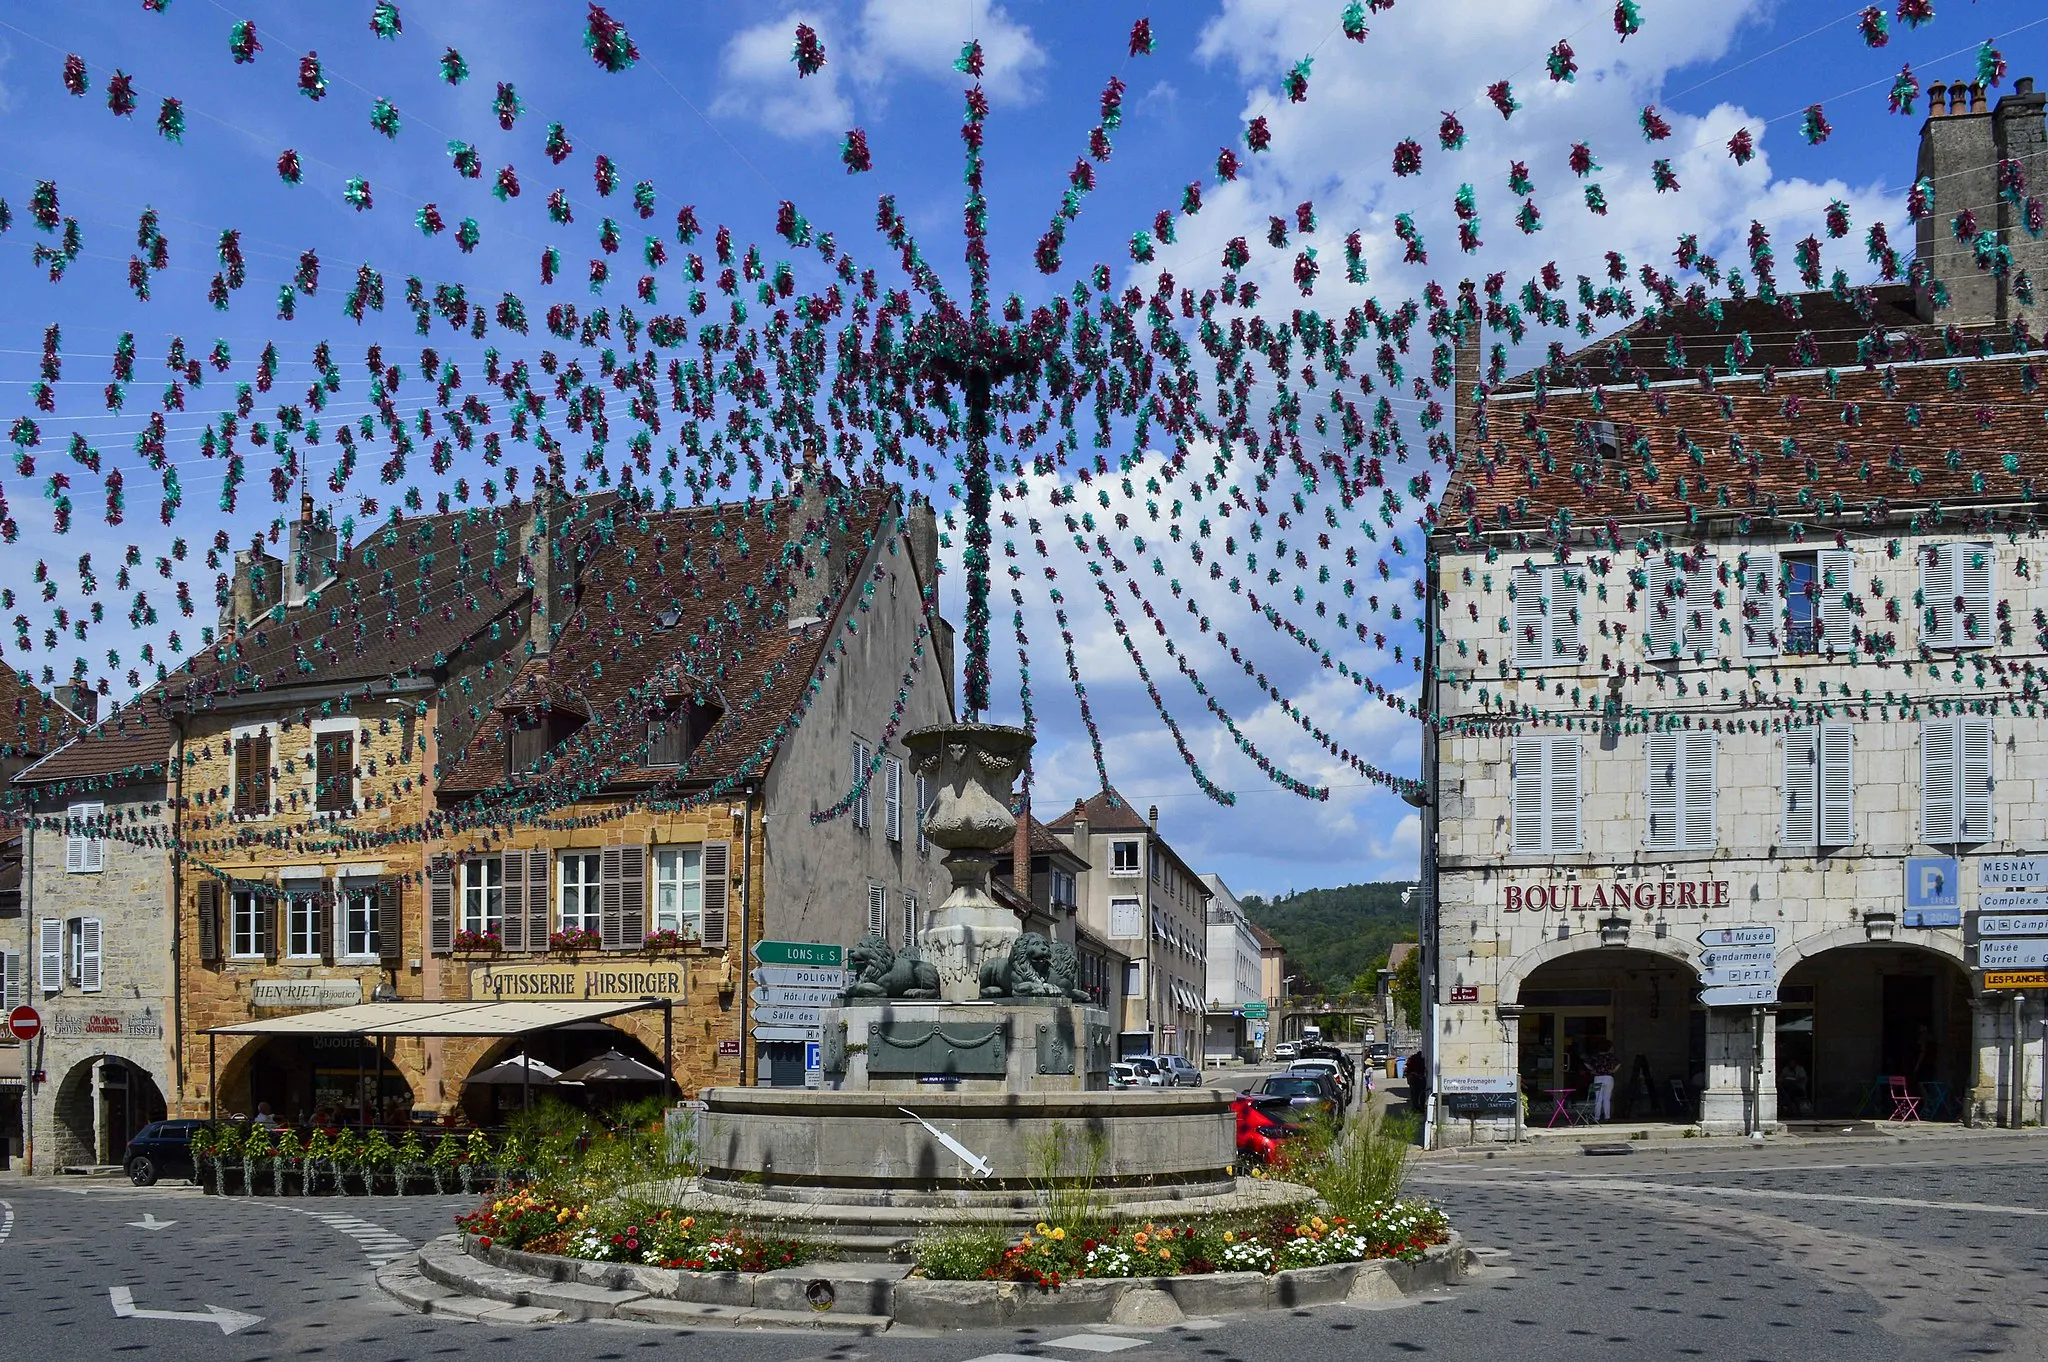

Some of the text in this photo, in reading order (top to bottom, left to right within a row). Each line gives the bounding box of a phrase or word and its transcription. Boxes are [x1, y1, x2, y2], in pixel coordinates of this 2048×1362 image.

[1983, 861, 2035, 872] MESNAY
[1984, 873, 2041, 882] ANDELOT
[1503, 880, 1731, 913] BOULANGERIE
[1931, 895, 1956, 905] LIBRE
[1984, 896, 2039, 907] Complexe
[1735, 931, 1771, 941] Musée
[1984, 942, 2019, 952] Musée
[787, 948, 813, 960] LONS
[816, 953, 824, 961] LE
[829, 950, 839, 961] S.
[1709, 951, 1771, 962] Gendarmerie
[1984, 954, 2017, 964] Sarret
[2024, 954, 2036, 963] de
[796, 972, 839, 982] POLIGNY
[1988, 974, 2048, 984] LES PLANCHES
[482, 971, 680, 997] PATISSERIE HIRSINGER
[321, 989, 356, 999] Bijoutier
[808, 992, 819, 1001] de
[772, 1010, 794, 1020] Salle
[798, 1012, 813, 1021] des
[1466, 1078, 1497, 1086] Fromagère
